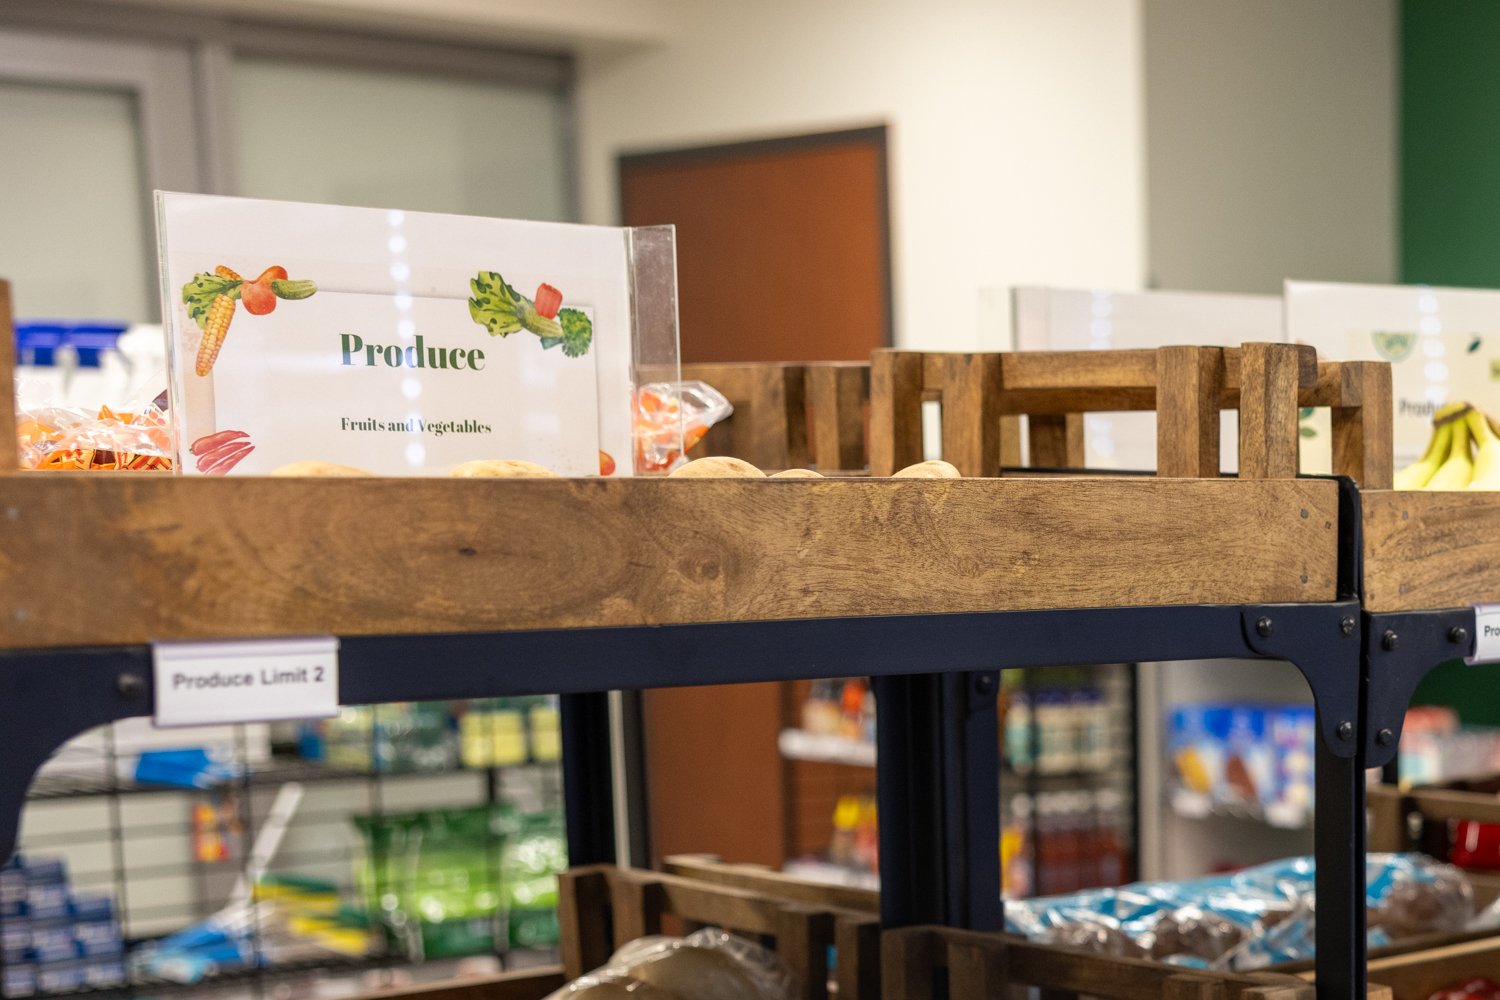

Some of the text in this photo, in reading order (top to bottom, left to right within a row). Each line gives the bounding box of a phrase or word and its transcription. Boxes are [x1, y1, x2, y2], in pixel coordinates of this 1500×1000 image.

[339, 333, 486, 371] Produce
[340, 417, 492, 436] Fruits and Vegetables
[172, 666, 324, 690] Produce Limit 2
